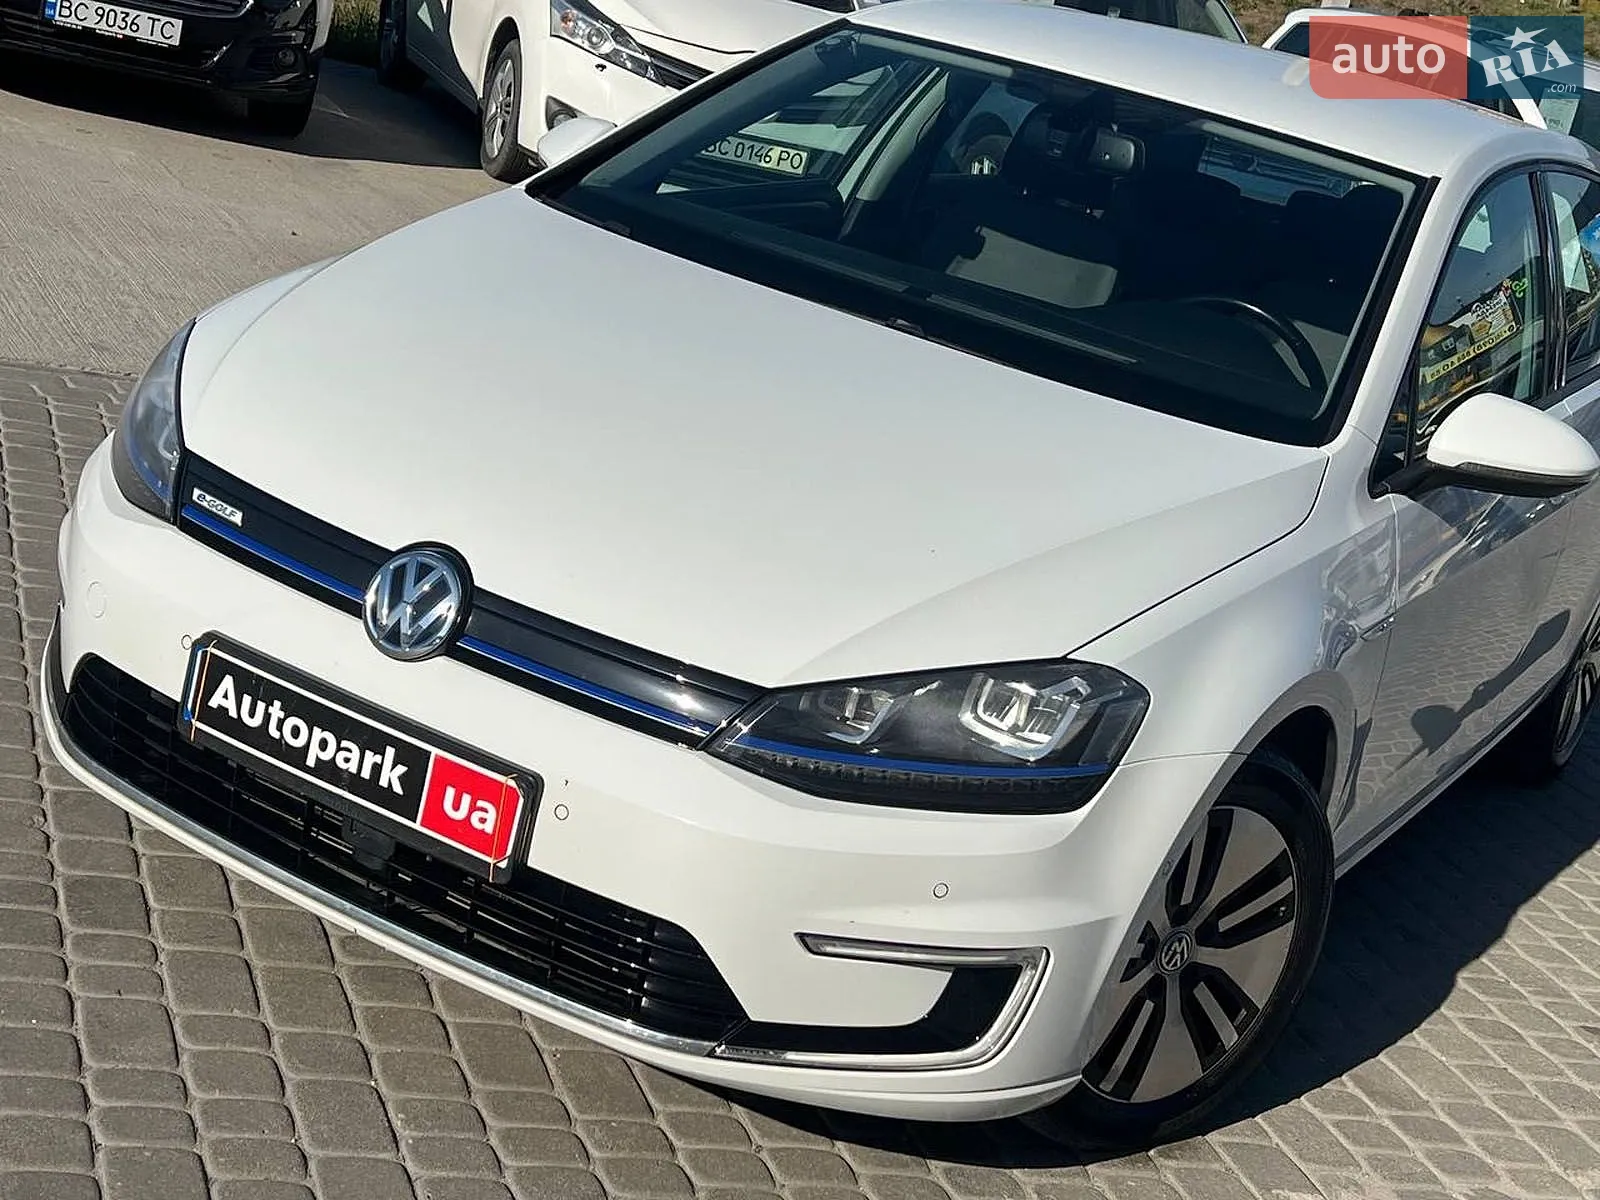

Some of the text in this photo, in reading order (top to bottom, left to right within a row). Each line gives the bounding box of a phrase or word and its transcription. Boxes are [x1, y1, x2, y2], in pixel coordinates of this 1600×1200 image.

[58, 0, 89, 21] BC
[94, 7, 141, 33] 9036
[147, 16, 175, 39] TC
[734, 142, 774, 164] 0146
[777, 150, 803, 170] PO
[207, 674, 498, 835] Autopark ua
